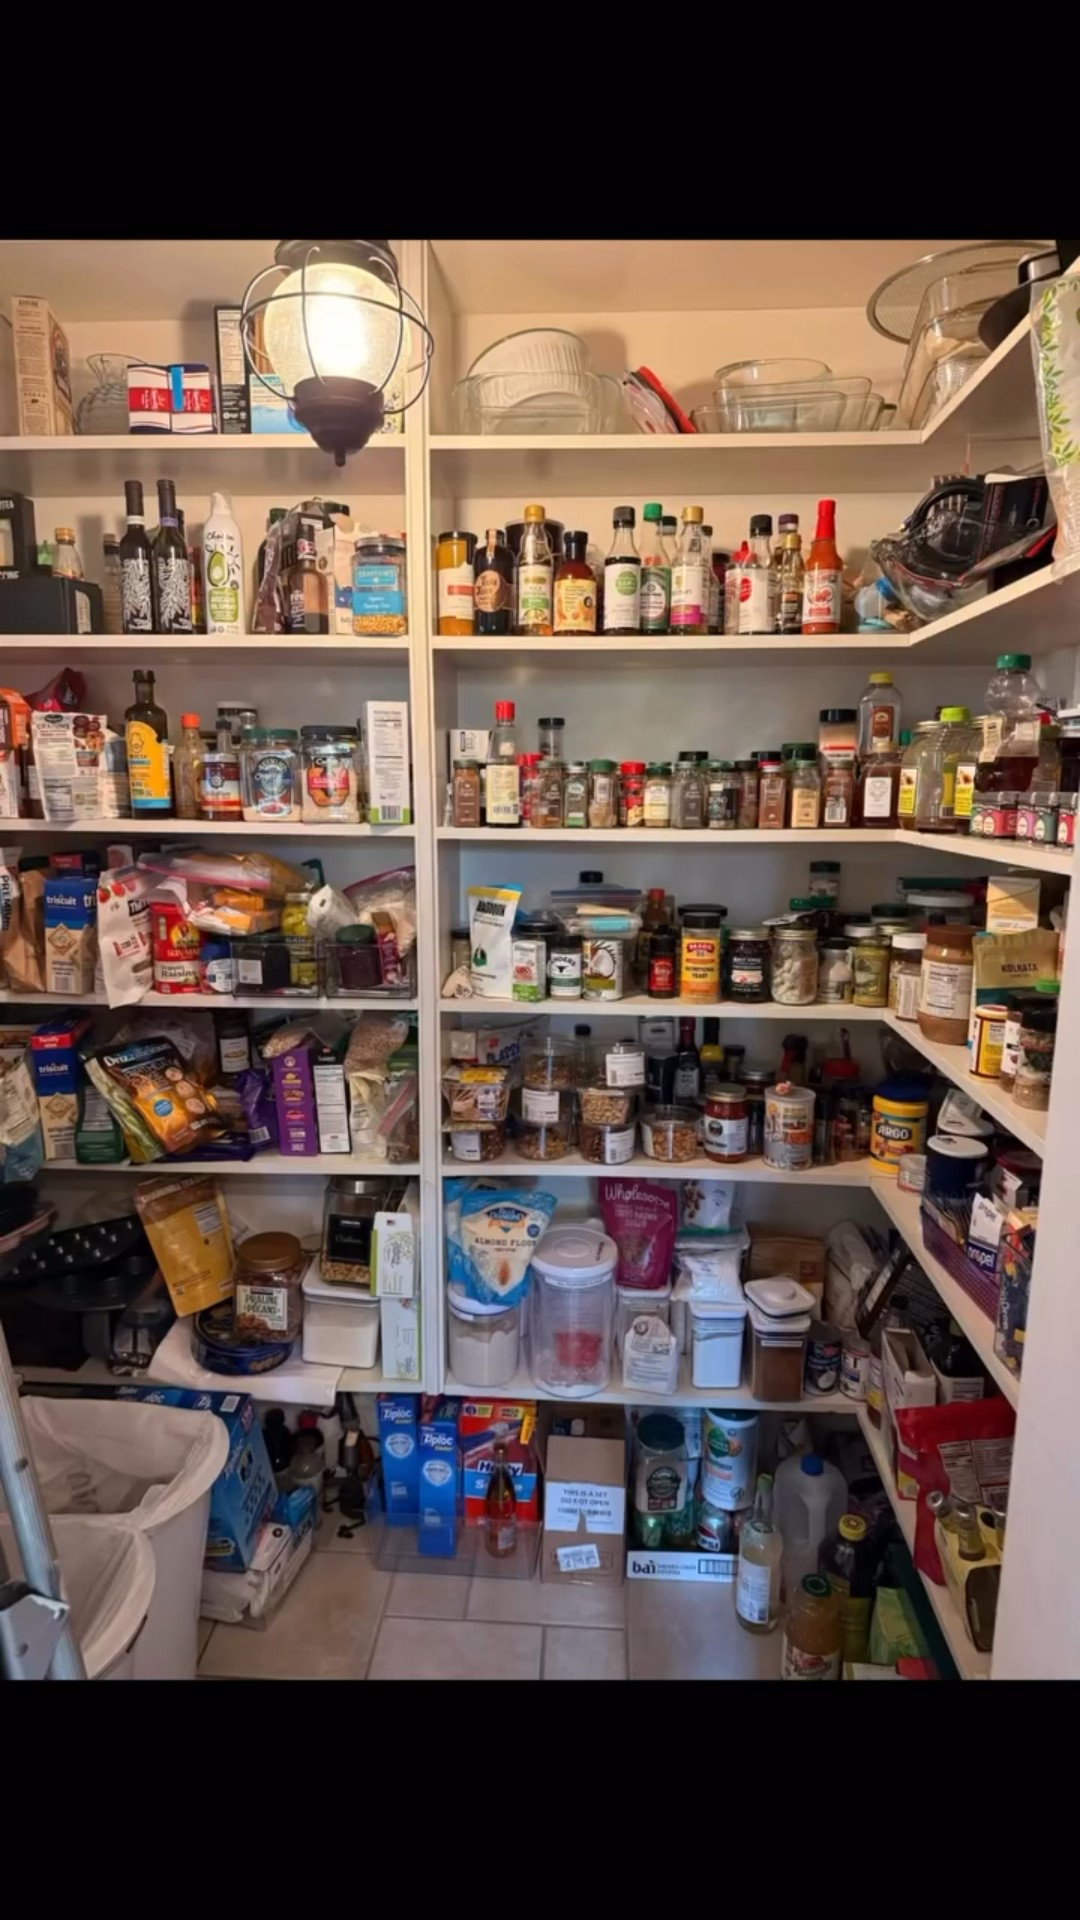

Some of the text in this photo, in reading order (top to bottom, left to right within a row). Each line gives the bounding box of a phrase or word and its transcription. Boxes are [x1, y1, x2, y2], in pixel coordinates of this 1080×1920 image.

[46, 894, 77, 906] triscuit
[1002, 963, 1038, 974] KOLKATA
[38, 1062, 69, 1074] triscuit
[878, 1125, 909, 1139] ARGO
[605, 1183, 670, 1209] Wholesome
[474, 1237, 507, 1246] ALMOND
[384, 1407, 412, 1421] Ziploc
[424, 1433, 454, 1447] Ziploc
[632, 1559, 656, 1574] bai
